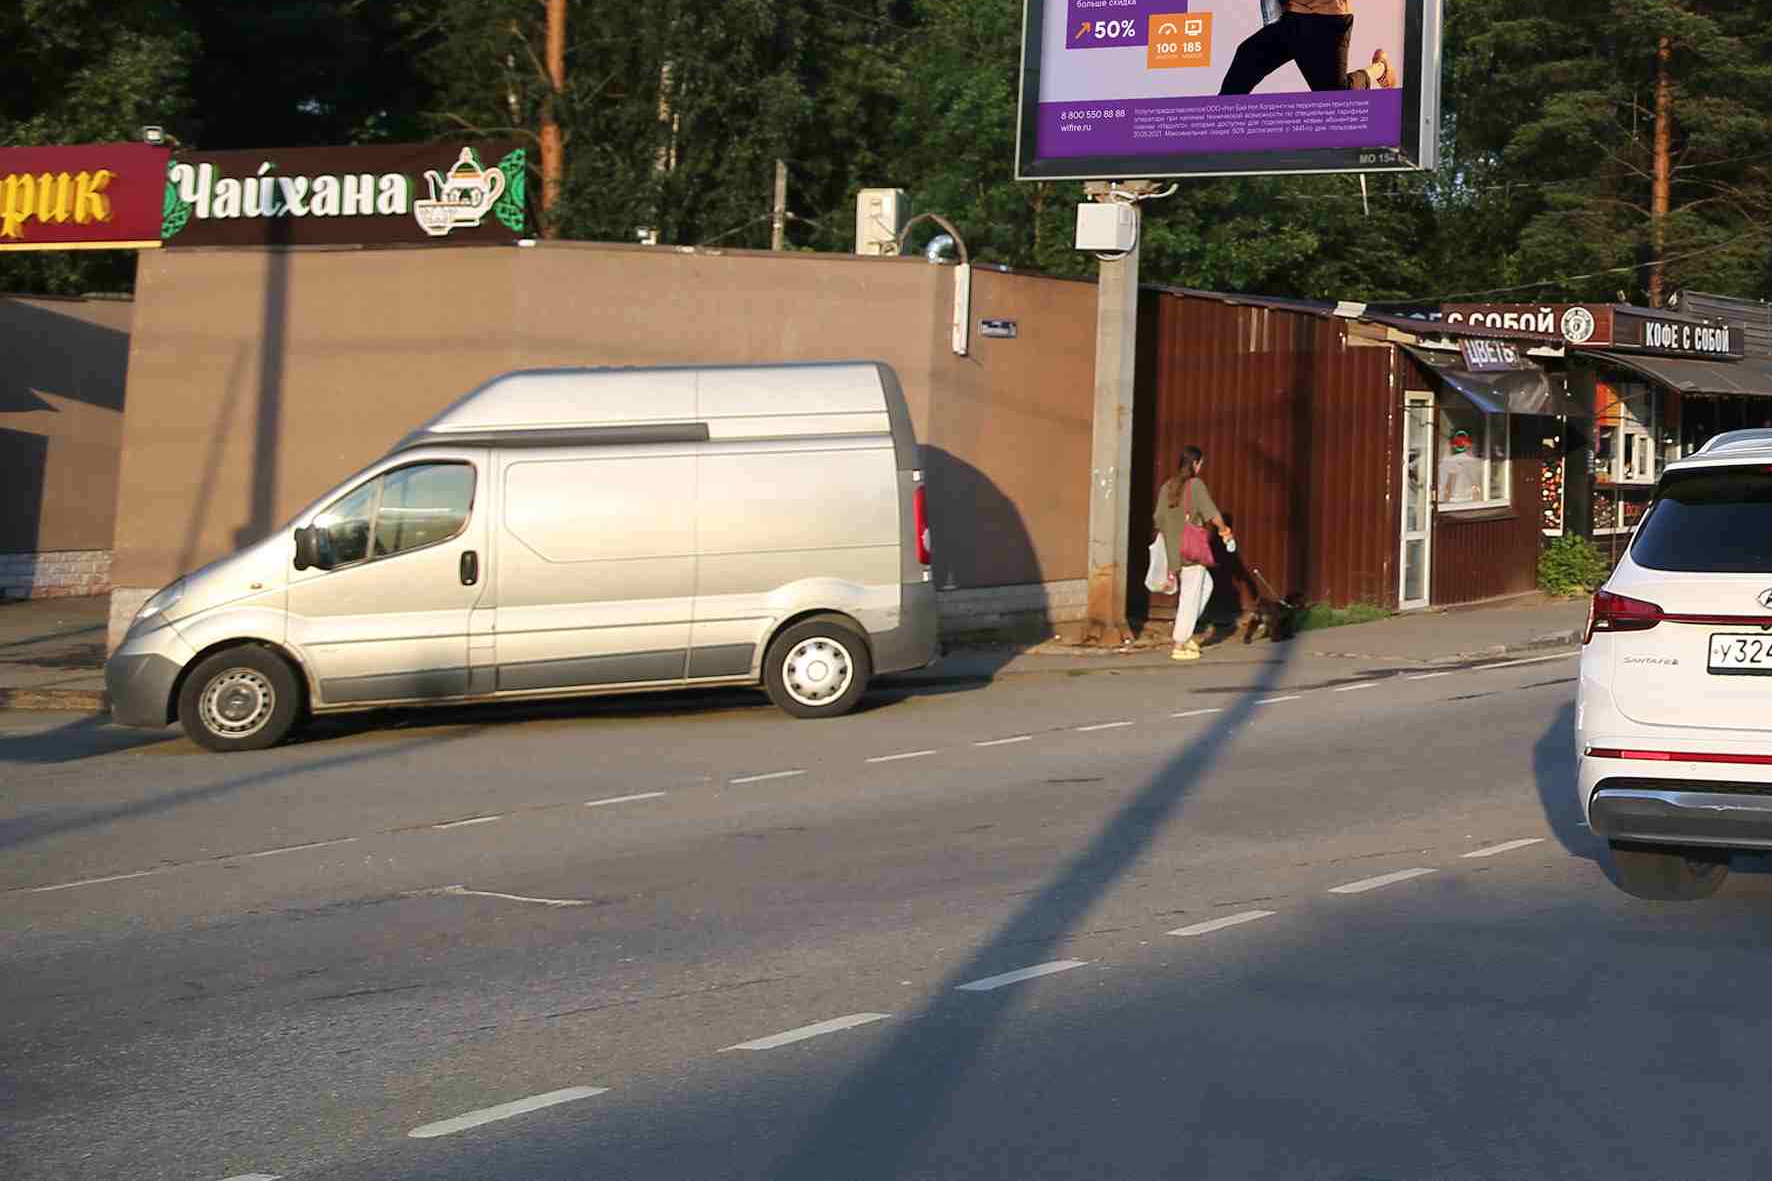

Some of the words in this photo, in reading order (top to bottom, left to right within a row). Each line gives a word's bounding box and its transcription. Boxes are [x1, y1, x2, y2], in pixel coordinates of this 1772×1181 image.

[1094, 19, 1136, 39] 50%
[1156, 42, 1177, 53] 100
[1183, 41, 1202, 53] 185
[1086, 110, 1102, 119] 550
[1060, 123, 1092, 133] wifire.ru
[168, 161, 409, 220] Чайхана
[1468, 307, 1555, 333] СОБОЙ
[1645, 322, 1679, 349] КОФЕ
[1682, 325, 1691, 350] С
[1694, 325, 1730, 353] СОБОЙ
